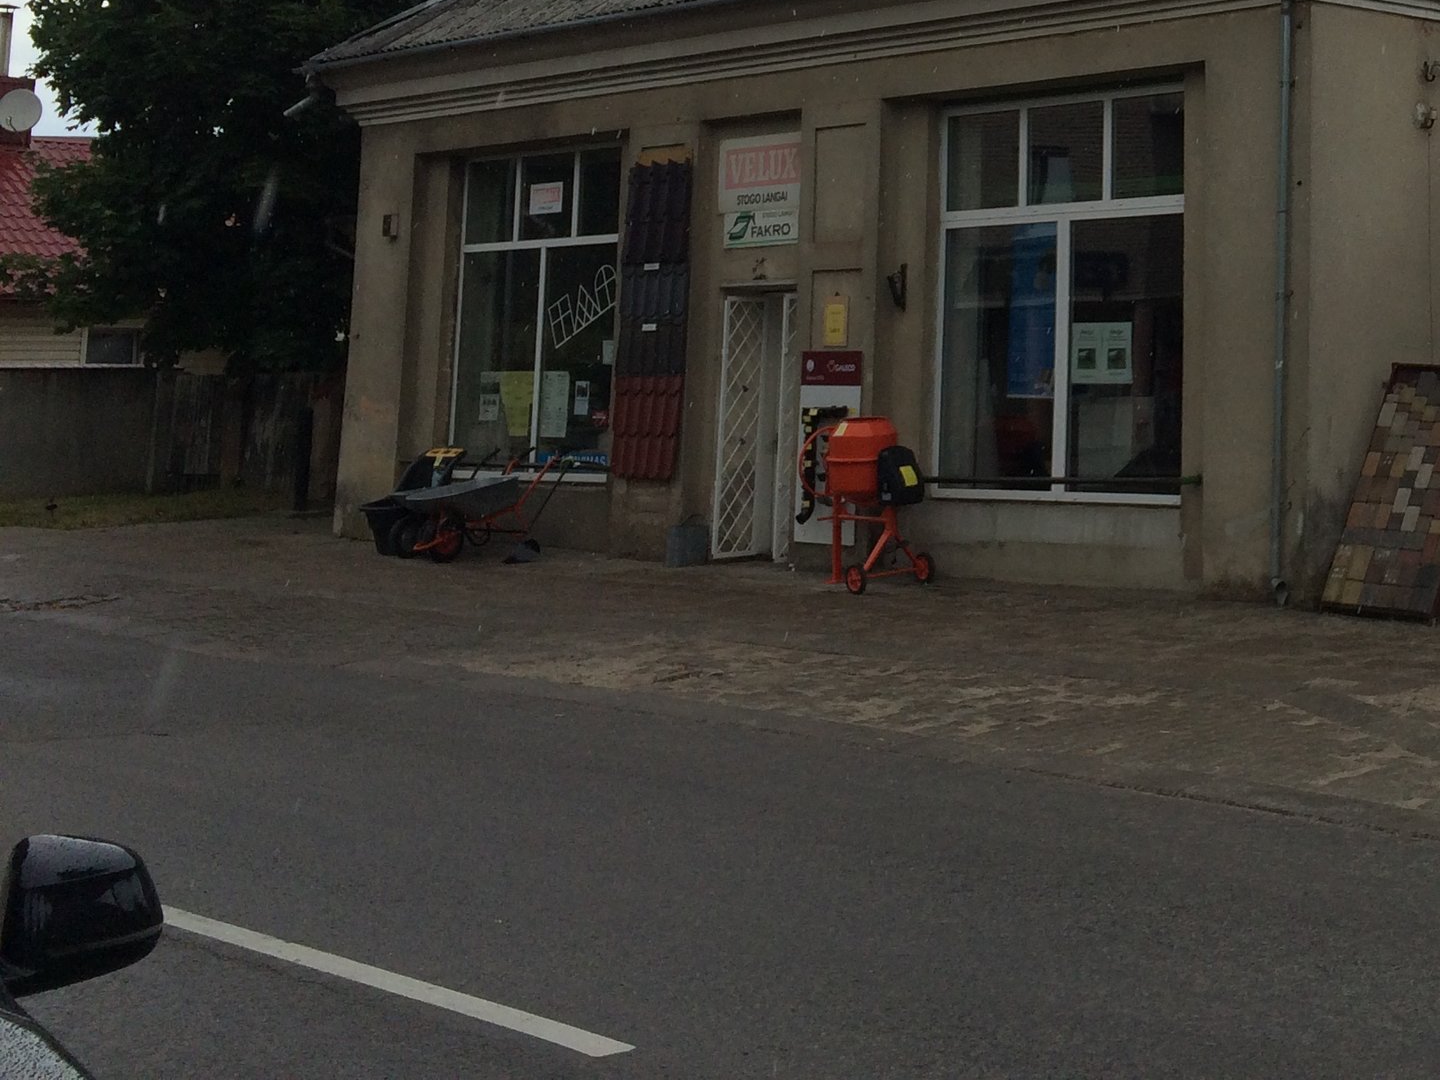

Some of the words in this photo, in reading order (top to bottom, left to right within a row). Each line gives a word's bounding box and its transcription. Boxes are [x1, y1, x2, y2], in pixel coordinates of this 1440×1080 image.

[729, 148, 798, 183] VELUX
[737, 194, 761, 206] STOGO
[762, 191, 788, 203] LANGAI
[751, 223, 791, 238] FAKRO
